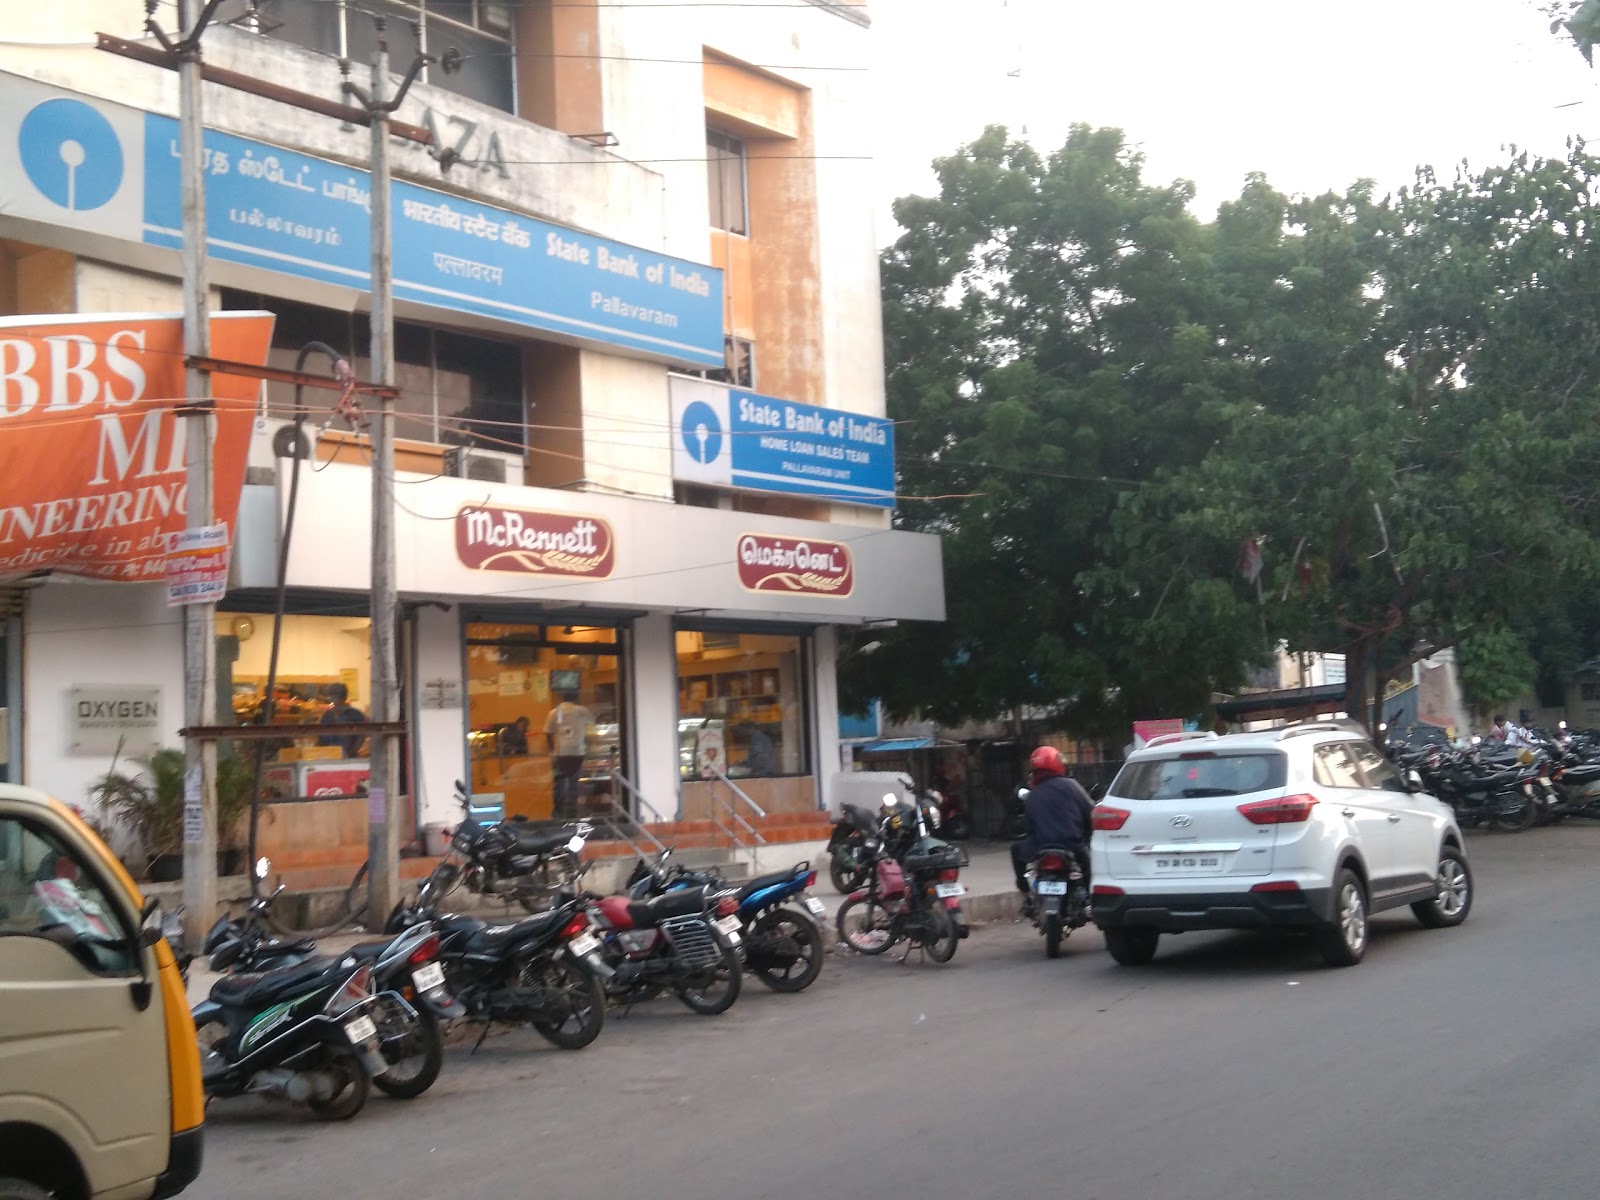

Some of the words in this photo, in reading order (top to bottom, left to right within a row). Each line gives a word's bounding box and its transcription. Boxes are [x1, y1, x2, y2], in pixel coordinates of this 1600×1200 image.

[403, 199, 462, 231] भारतीय
[463, 213, 499, 241] स्टेट
[432, 252, 504, 286] पल्लावरम
[546, 231, 590, 266] State
[596, 245, 639, 280] Bank
[645, 262, 664, 285] of
[669, 265, 710, 298] India
[590, 291, 678, 328] Pallavaram
[739, 397, 780, 428] State
[784, 406, 824, 436] Bank
[828, 416, 845, 439] of
[848, 418, 886, 447] India
[760, 435, 789, 452] HOME
[789, 440, 815, 457] LOAN
[816, 444, 844, 462] SALES
[845, 449, 870, 465] TEAM
[104, 536, 133, 557] in
[463, 508, 598, 554] McRennett
[78, 700, 158, 718] OXYGEN
